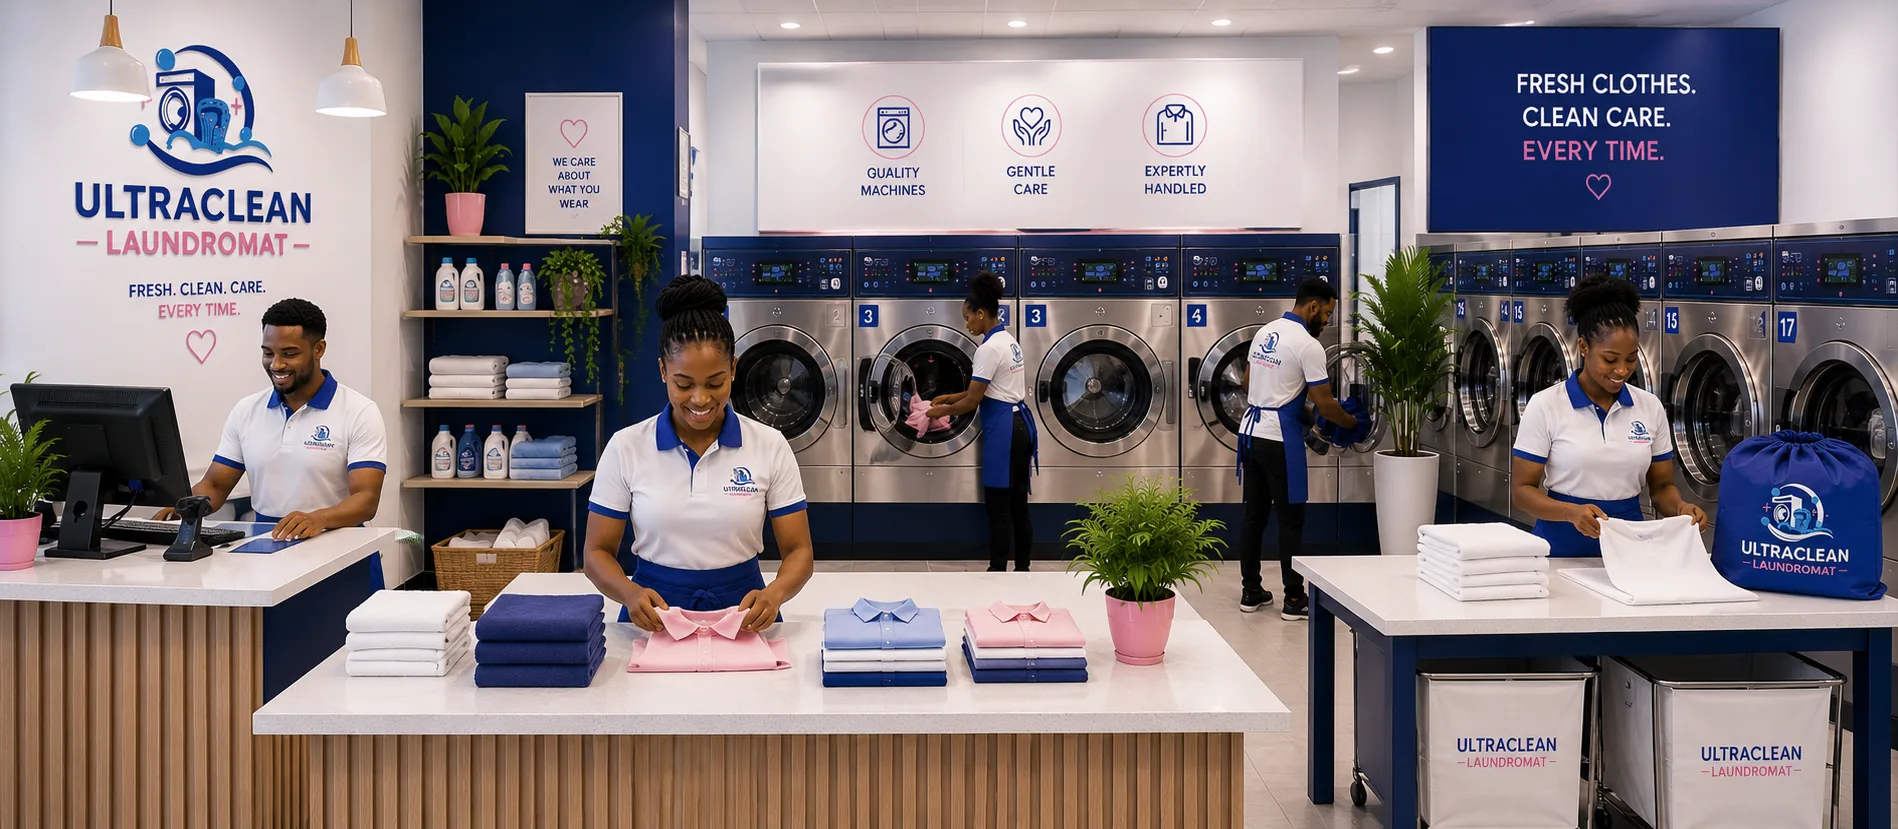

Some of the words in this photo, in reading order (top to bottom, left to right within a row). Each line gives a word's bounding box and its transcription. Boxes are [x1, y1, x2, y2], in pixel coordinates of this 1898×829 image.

[1518, 74, 1584, 94] FRESH
[1592, 74, 1697, 95] CLOTHES.
[1522, 107, 1598, 128] CLEAN
[1606, 107, 1671, 128] CARE.
[1523, 140, 1597, 161] EVERY
[1604, 140, 1665, 161] TIME.
[552, 157, 568, 167] WE
[570, 157, 596, 167] CARE
[557, 170, 591, 181] ABOUT
[866, 166, 920, 180] QUALITY
[1006, 165, 1056, 178] GENTLE
[1145, 165, 1206, 177] EXPERTLY
[548, 184, 577, 195] WHAT
[580, 184, 600, 195] YOU
[860, 184, 926, 196] MACHINES
[1013, 183, 1048, 195] CARE
[1145, 182, 1207, 195] HANDLED
[75, 182, 312, 224] ULTRACLEAN
[559, 199, 589, 209] WEAR
[107, 229, 289, 257] LAUNDROMAT
[129, 282, 177, 298] FRESH.
[180, 281, 227, 297] CLEAN.
[230, 280, 266, 294] CARE.
[158, 303, 202, 320] EVERY
[205, 302, 241, 317] TIME.
[864, 309, 873, 323] 3
[1031, 309, 1041, 323] 3
[1514, 305, 1523, 320] 15
[1666, 312, 1678, 329] 15
[1779, 317, 1796, 337] 17
[1741, 540, 1849, 563] ULTRACLEAN
[1752, 559, 1837, 576] LAUNDROMAT
[1457, 737, 1557, 753] ULTRACLEAN
[1701, 745, 1802, 762] ULTRACLEAN
[1467, 756, 1547, 768] LAUNDROMAT
[1711, 765, 1793, 778] LAUNDROMAT
